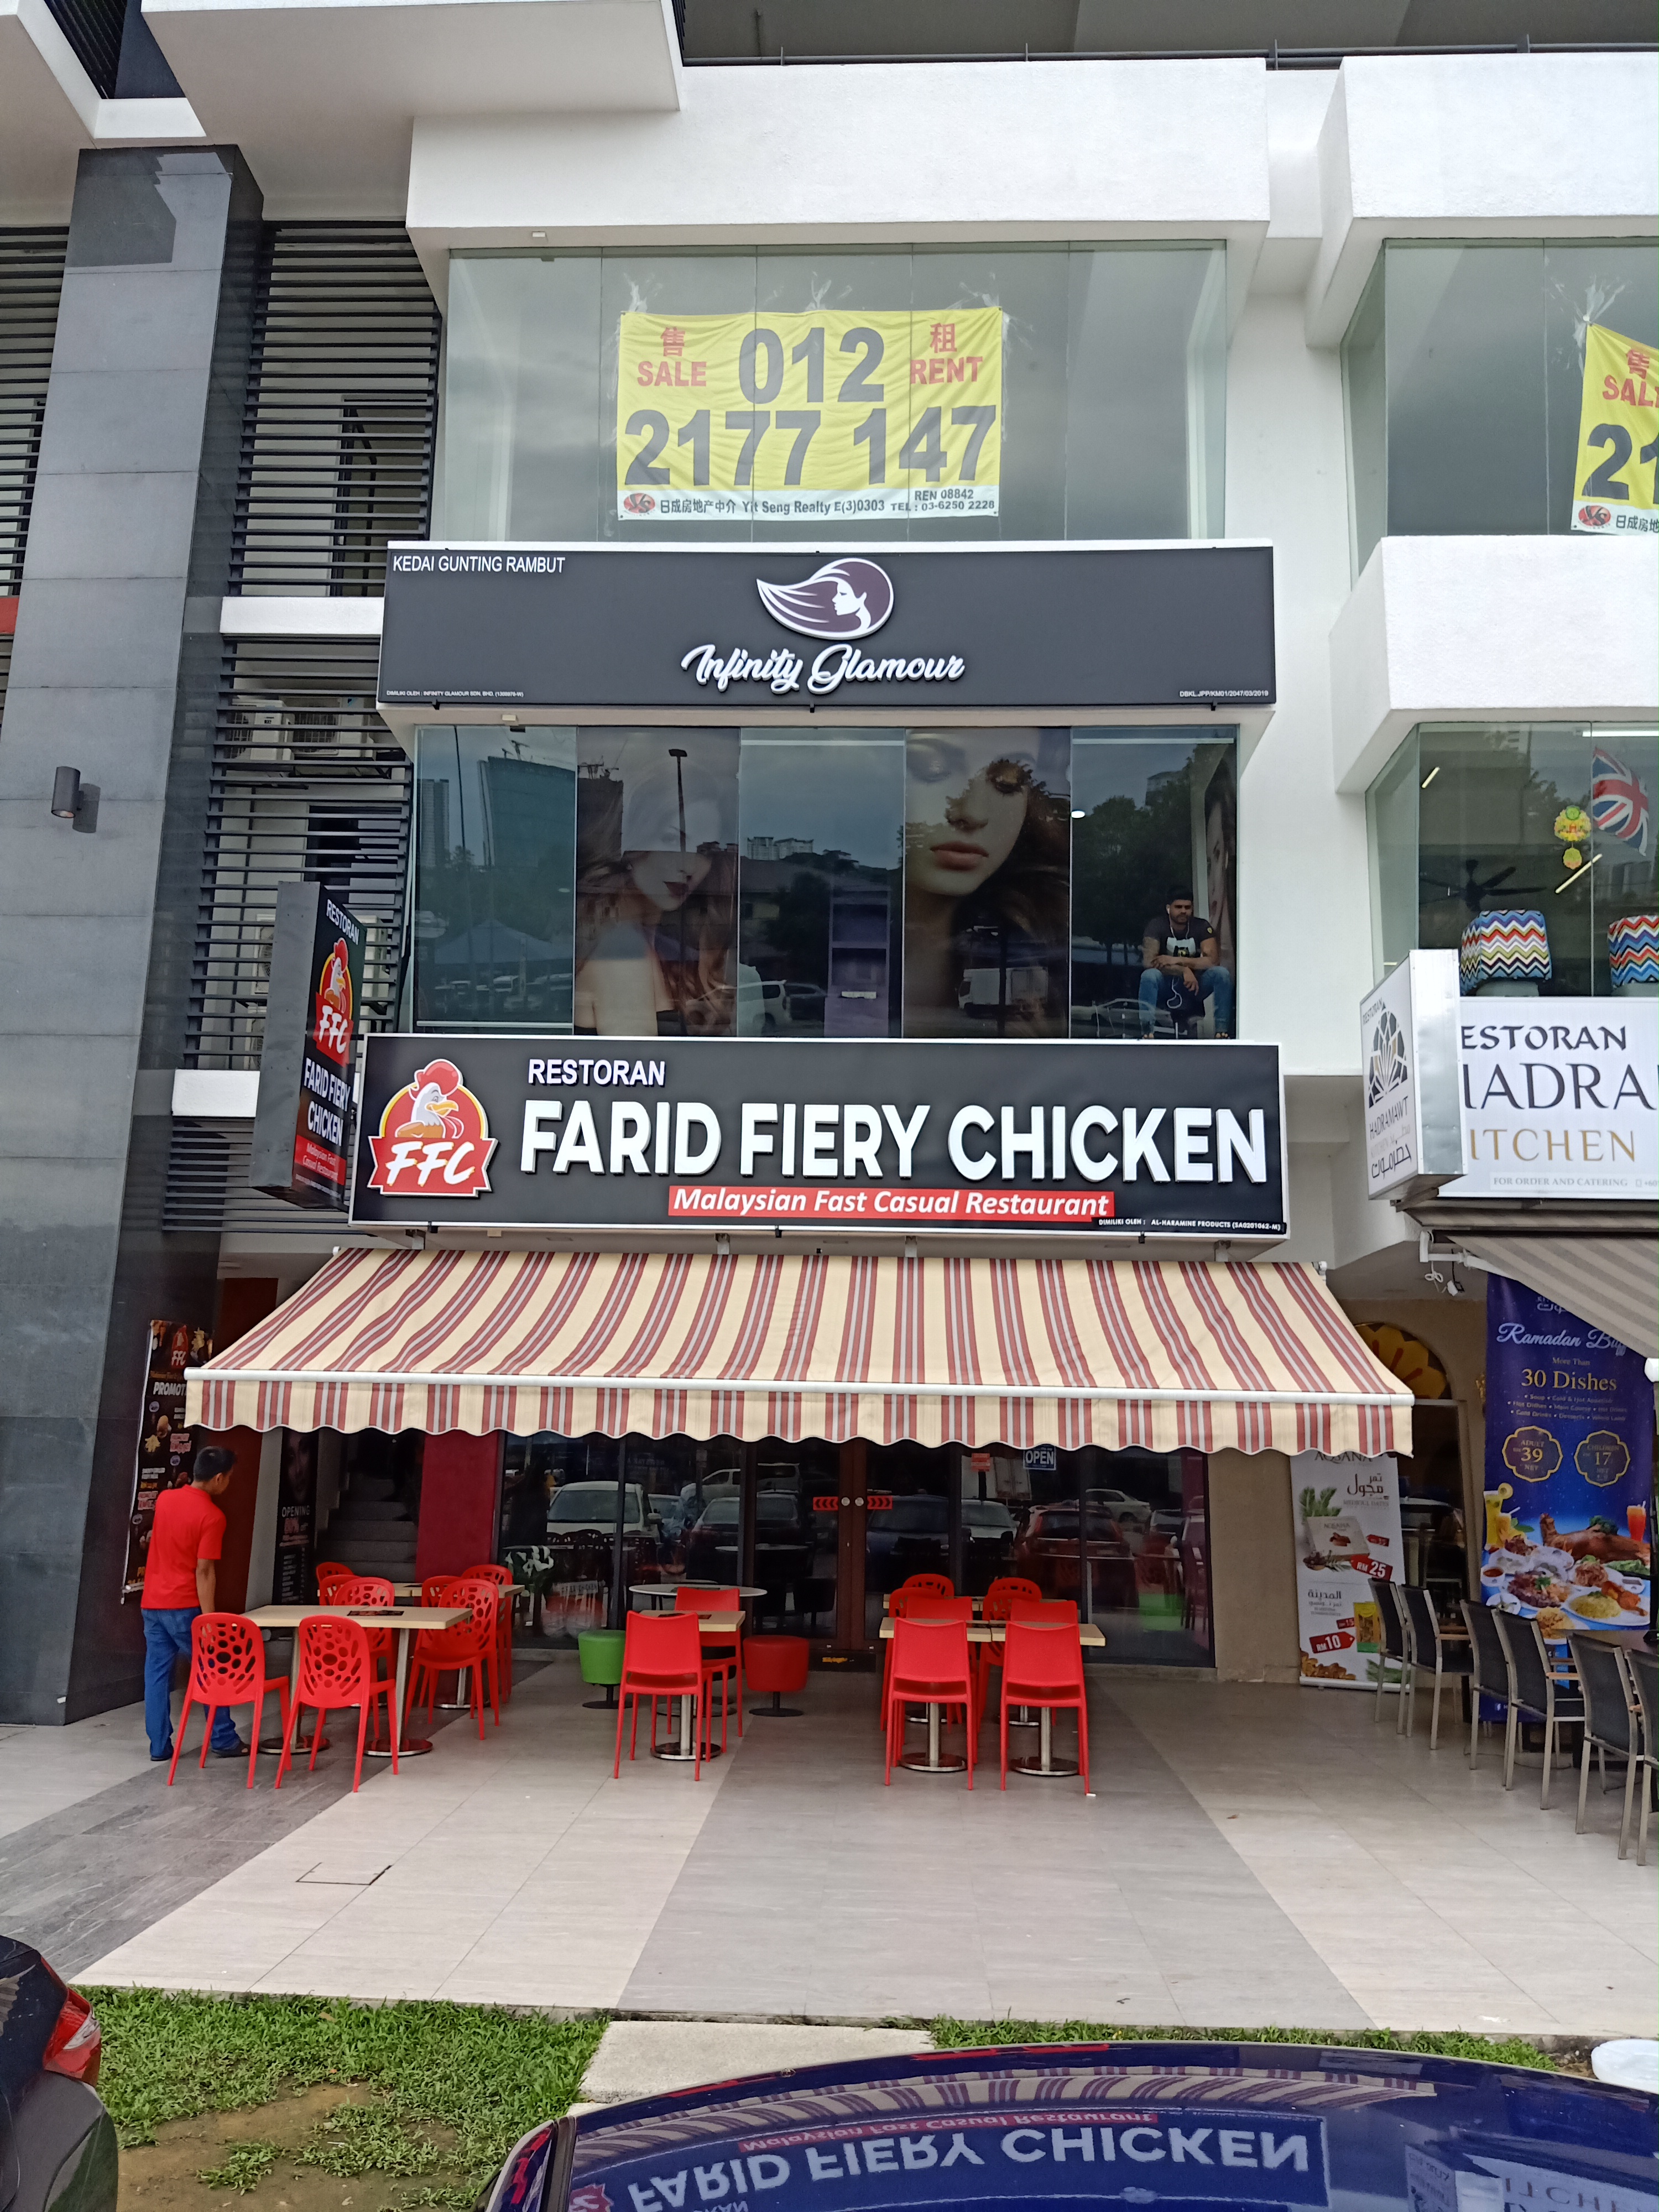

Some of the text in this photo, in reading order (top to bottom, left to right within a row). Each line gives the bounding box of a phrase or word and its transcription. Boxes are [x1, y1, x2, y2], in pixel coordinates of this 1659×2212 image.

[660, 327, 685, 357] 售
[930, 322, 957, 354] 租
[637, 361, 707, 387] SALE
[739, 327, 885, 404] 012
[910, 356, 983, 385] RENT
[1626, 349, 1650, 379] 售
[624, 405, 996, 487] 2177 147
[660, 499, 885, 515] 日成房地产中介 Yit Seng Realty E(3)0303
[891, 503, 911, 512] TEL
[921, 500, 964, 511] 03-6250
[968, 500, 995, 509] 2228
[915, 489, 974, 500] REN 08842
[393, 555, 566, 573] KEDAI GUNTING RAMBUT
[681, 644, 965, 695] Infinity Glamour
[326, 899, 359, 945] RESTORAN
[1363, 999, 1383, 1025] RESTORAN
[319, 1005, 348, 1054] FFC
[1461, 1025, 1626, 1050] ESTORAN
[304, 1057, 351, 1112] FARID FIERY
[528, 1058, 665, 1086] RESTORAN
[308, 1101, 343, 1146] CHICKEN
[1370, 1096, 1408, 1140] HADRAMAWT
[520, 1100, 1267, 1183] FARID FIERY CHICKEN
[1470, 1129, 1635, 1162] ITCHEN
[385, 1140, 475, 1188] FFC
[1494, 1177, 1513, 1186] FOR
[1515, 1177, 1550, 1186] ORDER
[1552, 1177, 1574, 1186] AND
[1577, 1178, 1628, 1187] CATERING
[674, 1188, 1109, 1216] Malaysian Fast Casual Restaurant
[1496, 1322, 1582, 1347] Ramadan
[1521, 1368, 1618, 1391] 30 Dishes
[1025, 1451, 1054, 1465] OPEN
[1521, 1447, 1543, 1463] 39
[1595, 1452, 1612, 1465] 17
[1347, 1474, 1384, 1497] مجول
[282, 1505, 310, 1517] OPENING
[1357, 1561, 1386, 1578] RM 25
[1316, 1635, 1342, 1652] RM 10
